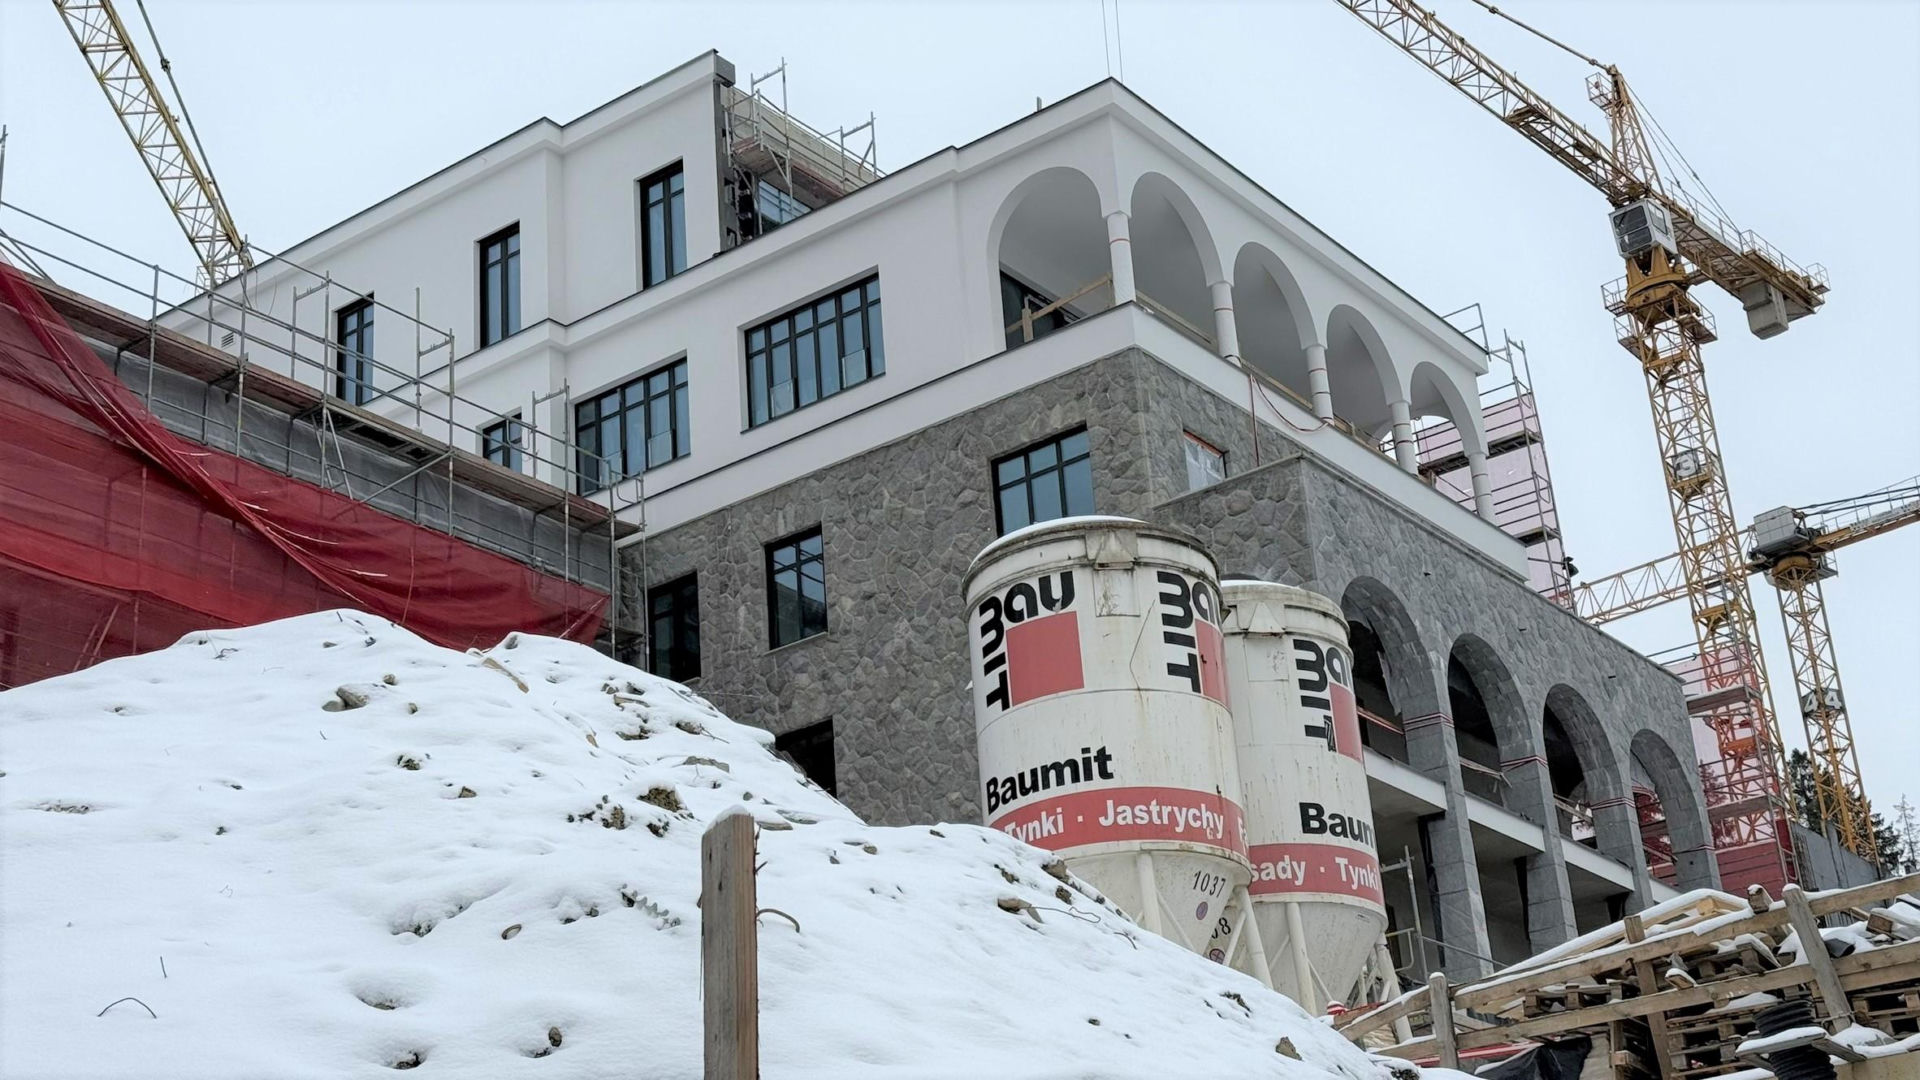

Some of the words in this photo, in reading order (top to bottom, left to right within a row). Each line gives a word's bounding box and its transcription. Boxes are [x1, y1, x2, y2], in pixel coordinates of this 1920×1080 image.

[986, 746, 1114, 815] Baumit
[1004, 807, 1064, 843] Tynki
[1099, 799, 1223, 839] Jastrychy
[1193, 870, 1226, 898] 1037
[1335, 857, 1378, 892] Tynki
